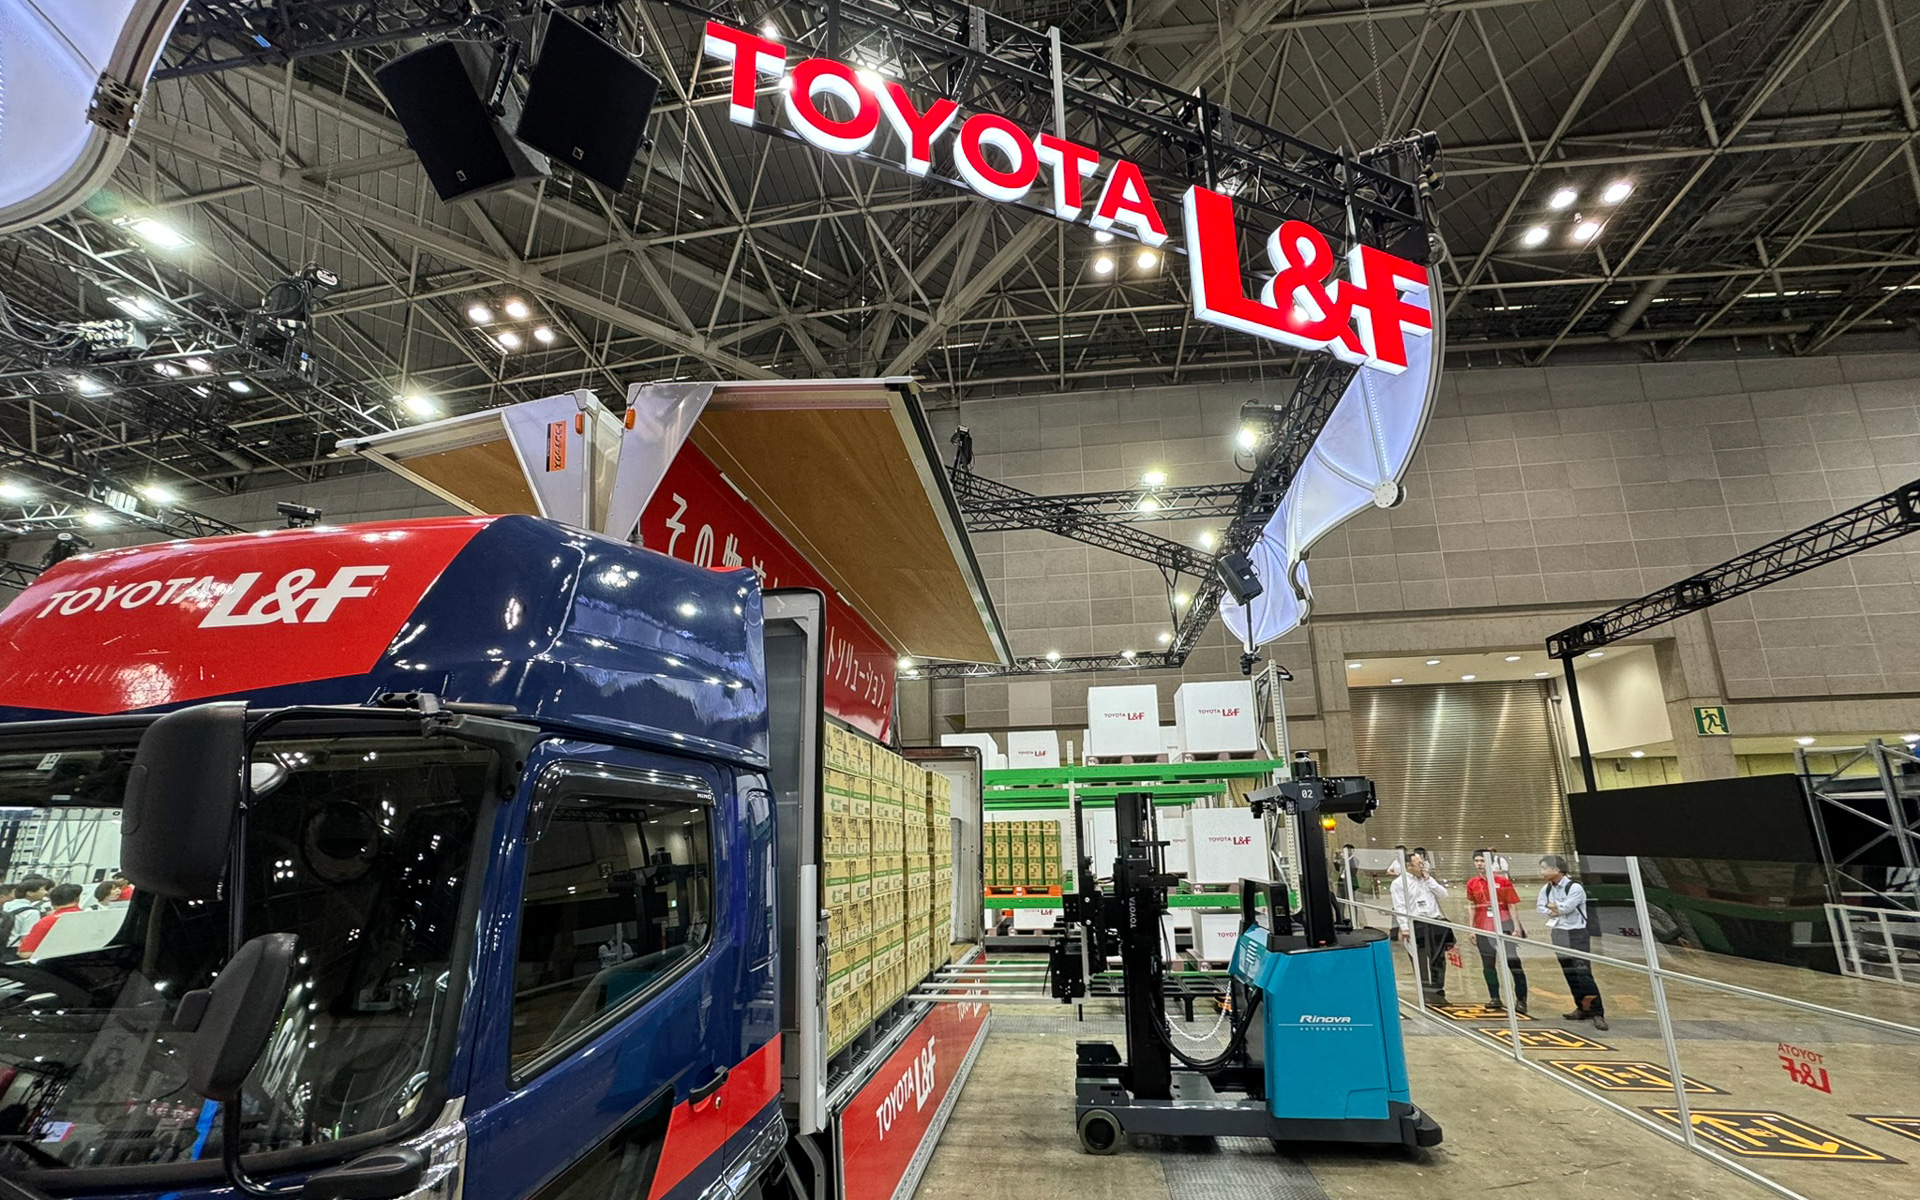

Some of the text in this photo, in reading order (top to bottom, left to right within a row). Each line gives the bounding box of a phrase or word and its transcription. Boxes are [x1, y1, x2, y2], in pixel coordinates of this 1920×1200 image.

[704, 20, 1432, 375] TOYOTA L&F
[36, 565, 390, 629] TOYOTA L&F
[825, 626, 887, 714] トソリューション。
[1127, 712, 1145, 721] L&F
[1222, 708, 1240, 717] L&F
[1301, 789, 1314, 799] 02
[1233, 836, 1251, 845] L&F
[1129, 896, 1137, 929] TOYOTA
[876, 1035, 936, 1141] TOYOTA L&F
